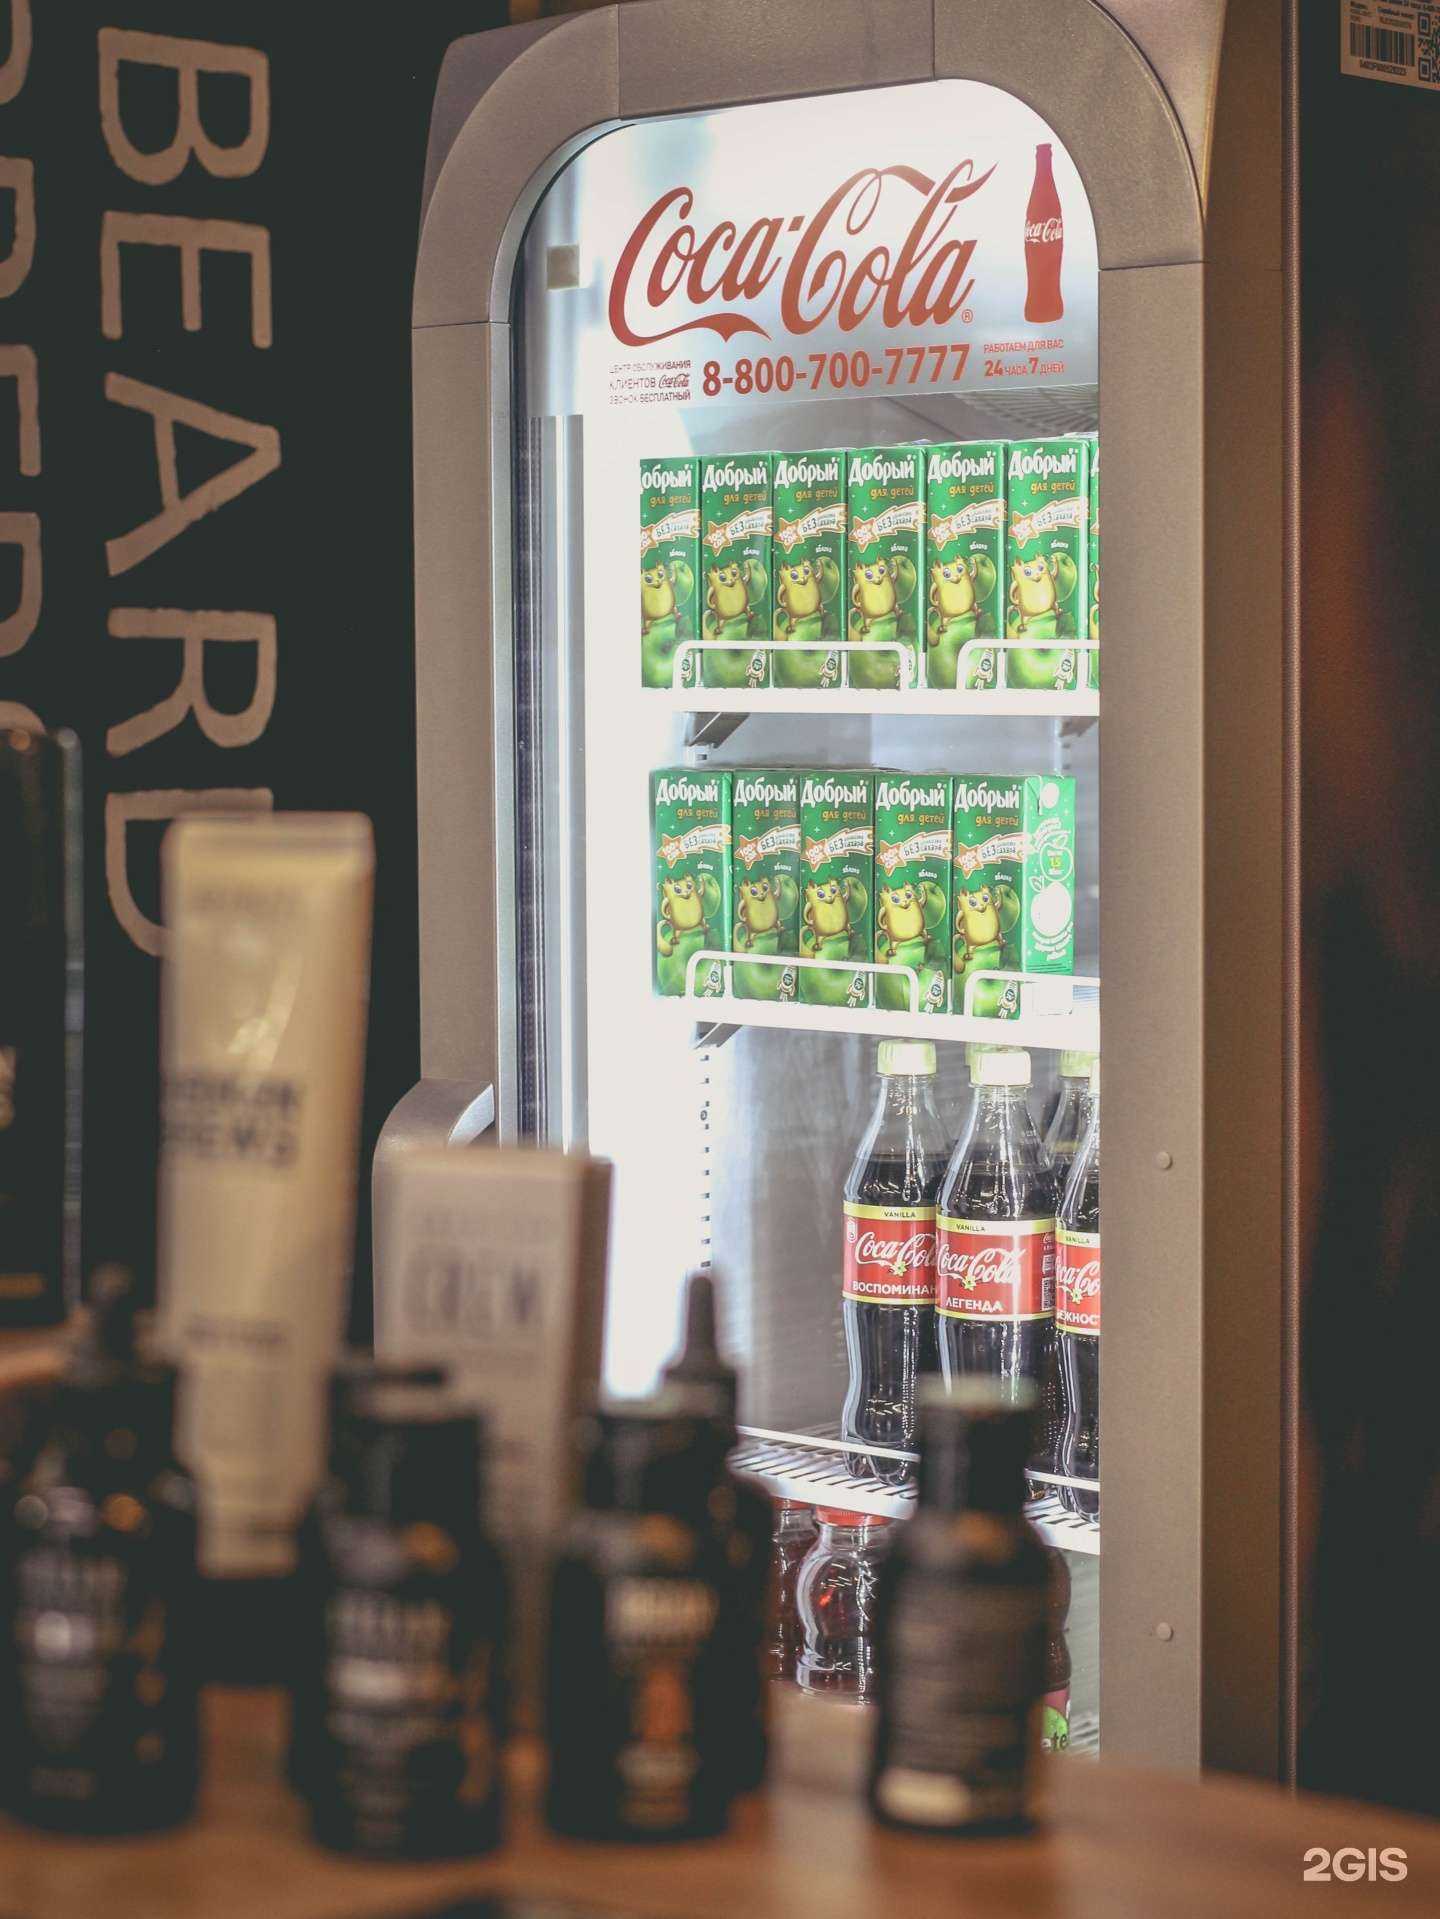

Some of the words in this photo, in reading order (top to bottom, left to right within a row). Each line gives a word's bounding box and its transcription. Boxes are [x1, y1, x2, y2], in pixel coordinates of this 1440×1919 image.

[608, 158, 999, 347] Coca-Cola
[983, 342, 1026, 354] РАБОТАЕМ
[1027, 340, 1047, 353] ДЛЯ
[1047, 338, 1064, 349] ВАС
[702, 343, 970, 397] 8-800-700-7777
[984, 359, 1003, 377] 24
[1028, 356, 1039, 375] 7
[1039, 360, 1064, 375] ДНЕЙ
[848, 454, 915, 487] Добрый
[927, 450, 995, 483] Добрый
[1008, 447, 1077, 481] Добрый
[640, 463, 692, 494] обрый
[702, 461, 768, 493] Добрый
[774, 457, 839, 489] Добрый
[870, 487, 888, 499] для
[949, 485, 966, 497] для
[1031, 482, 1048, 494] для
[650, 497, 666, 507] для
[724, 494, 740, 504] для
[795, 491, 812, 502] для
[729, 520, 745, 535] БЕЗ
[803, 517, 818, 532] БЕЗ
[877, 516, 892, 532] БЕЗ
[956, 511, 974, 529] БЕЗ
[655, 522, 671, 537] БЕЗ
[656, 777, 719, 807] Добрый
[734, 776, 797, 807] Добрый
[801, 778, 867, 808] Добрый
[875, 780, 945, 812] Добрый
[954, 782, 1020, 814] Добрый
[676, 808, 693, 819] для
[754, 809, 771, 820] для
[822, 810, 839, 821] для
[897, 814, 915, 825] для
[975, 815, 993, 826] для
[684, 835, 698, 849] БЕЗ
[761, 836, 776, 850] БЕЗ
[830, 838, 844, 852] БЕЗ
[903, 841, 920, 857] БЕЗ
[981, 844, 996, 859] БЕЗ
[883, 1211, 916, 1219] VANILLA
[956, 1223, 986, 1233] VANILLA
[1065, 1235, 1091, 1245] VANILLA
[945, 1296, 1005, 1312] ЛЕГЕНДА
